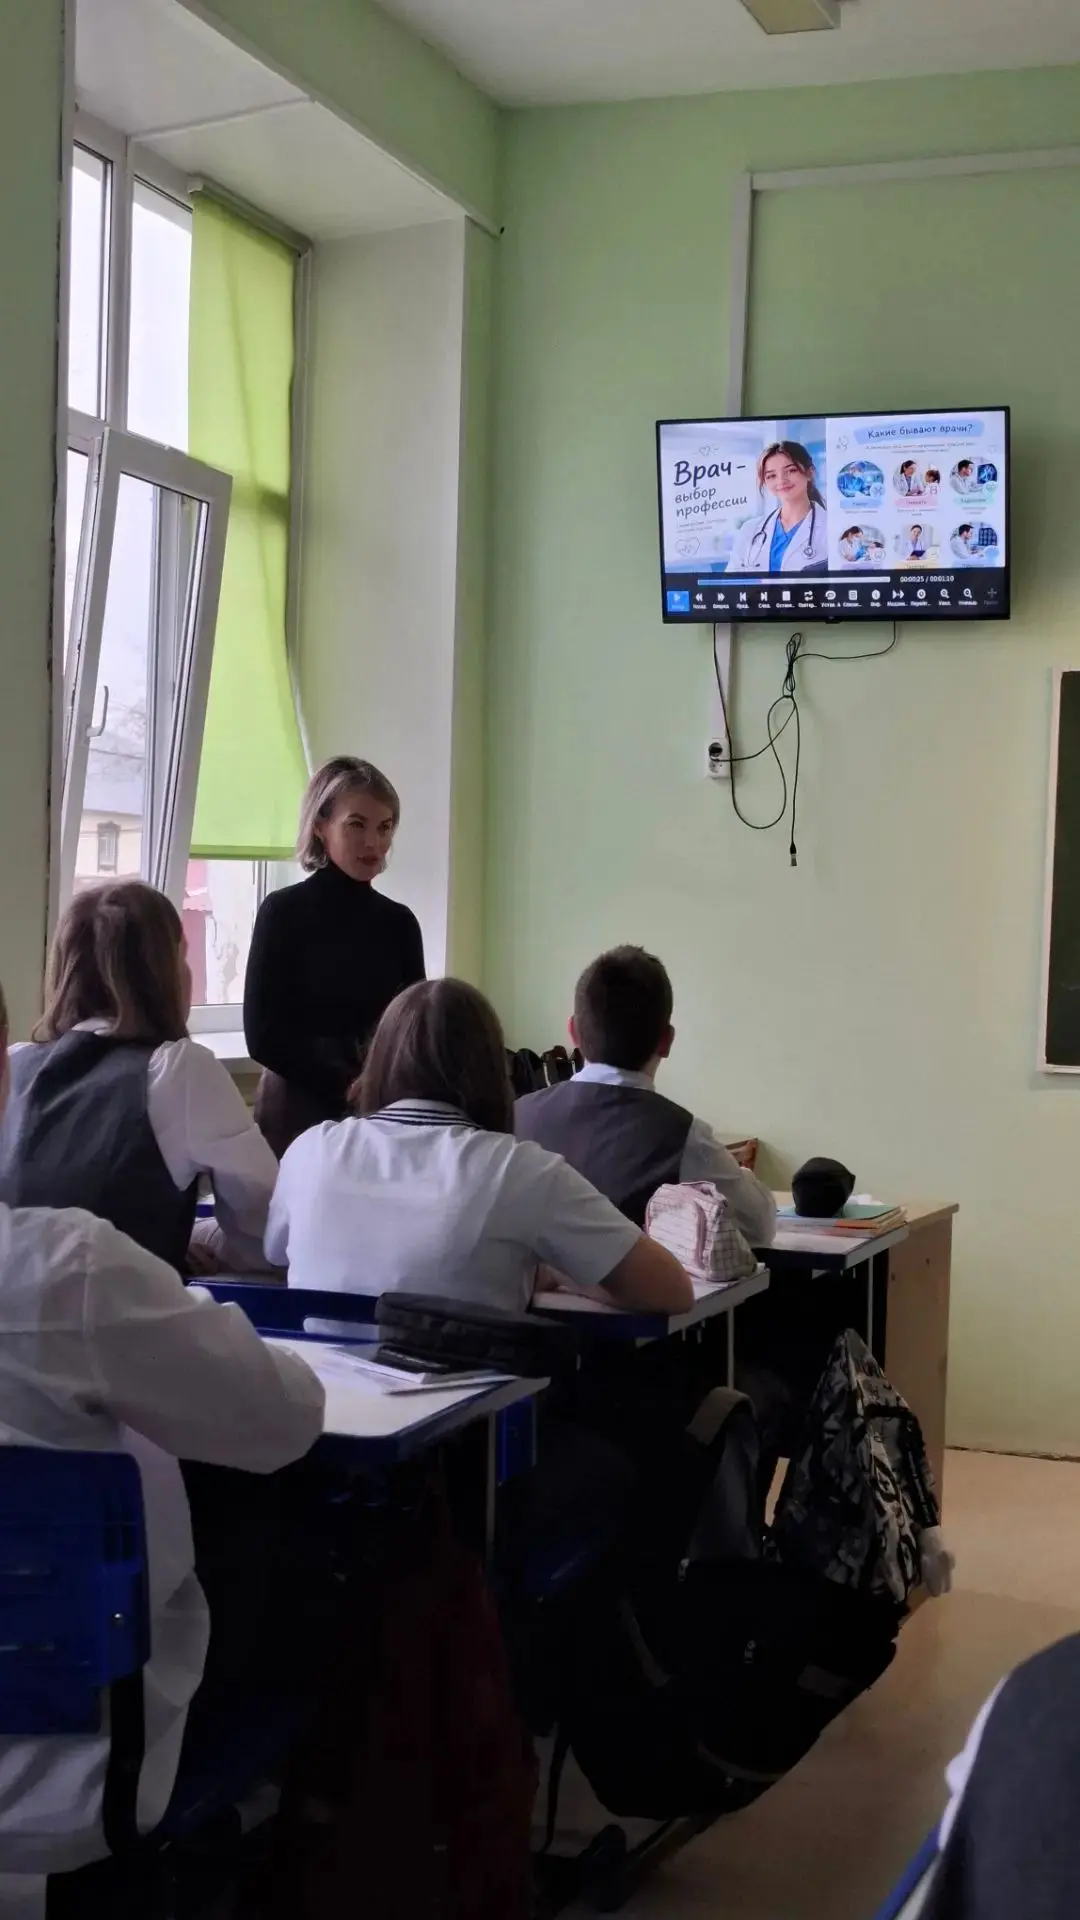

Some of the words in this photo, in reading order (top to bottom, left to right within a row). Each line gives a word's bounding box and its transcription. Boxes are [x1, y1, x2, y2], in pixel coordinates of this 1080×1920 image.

[867, 429, 896, 439] Какие
[899, 426, 936, 436] бывают
[940, 424, 973, 434] врачи?
[675, 486, 716, 504] выбор
[676, 496, 748, 520] профессии
